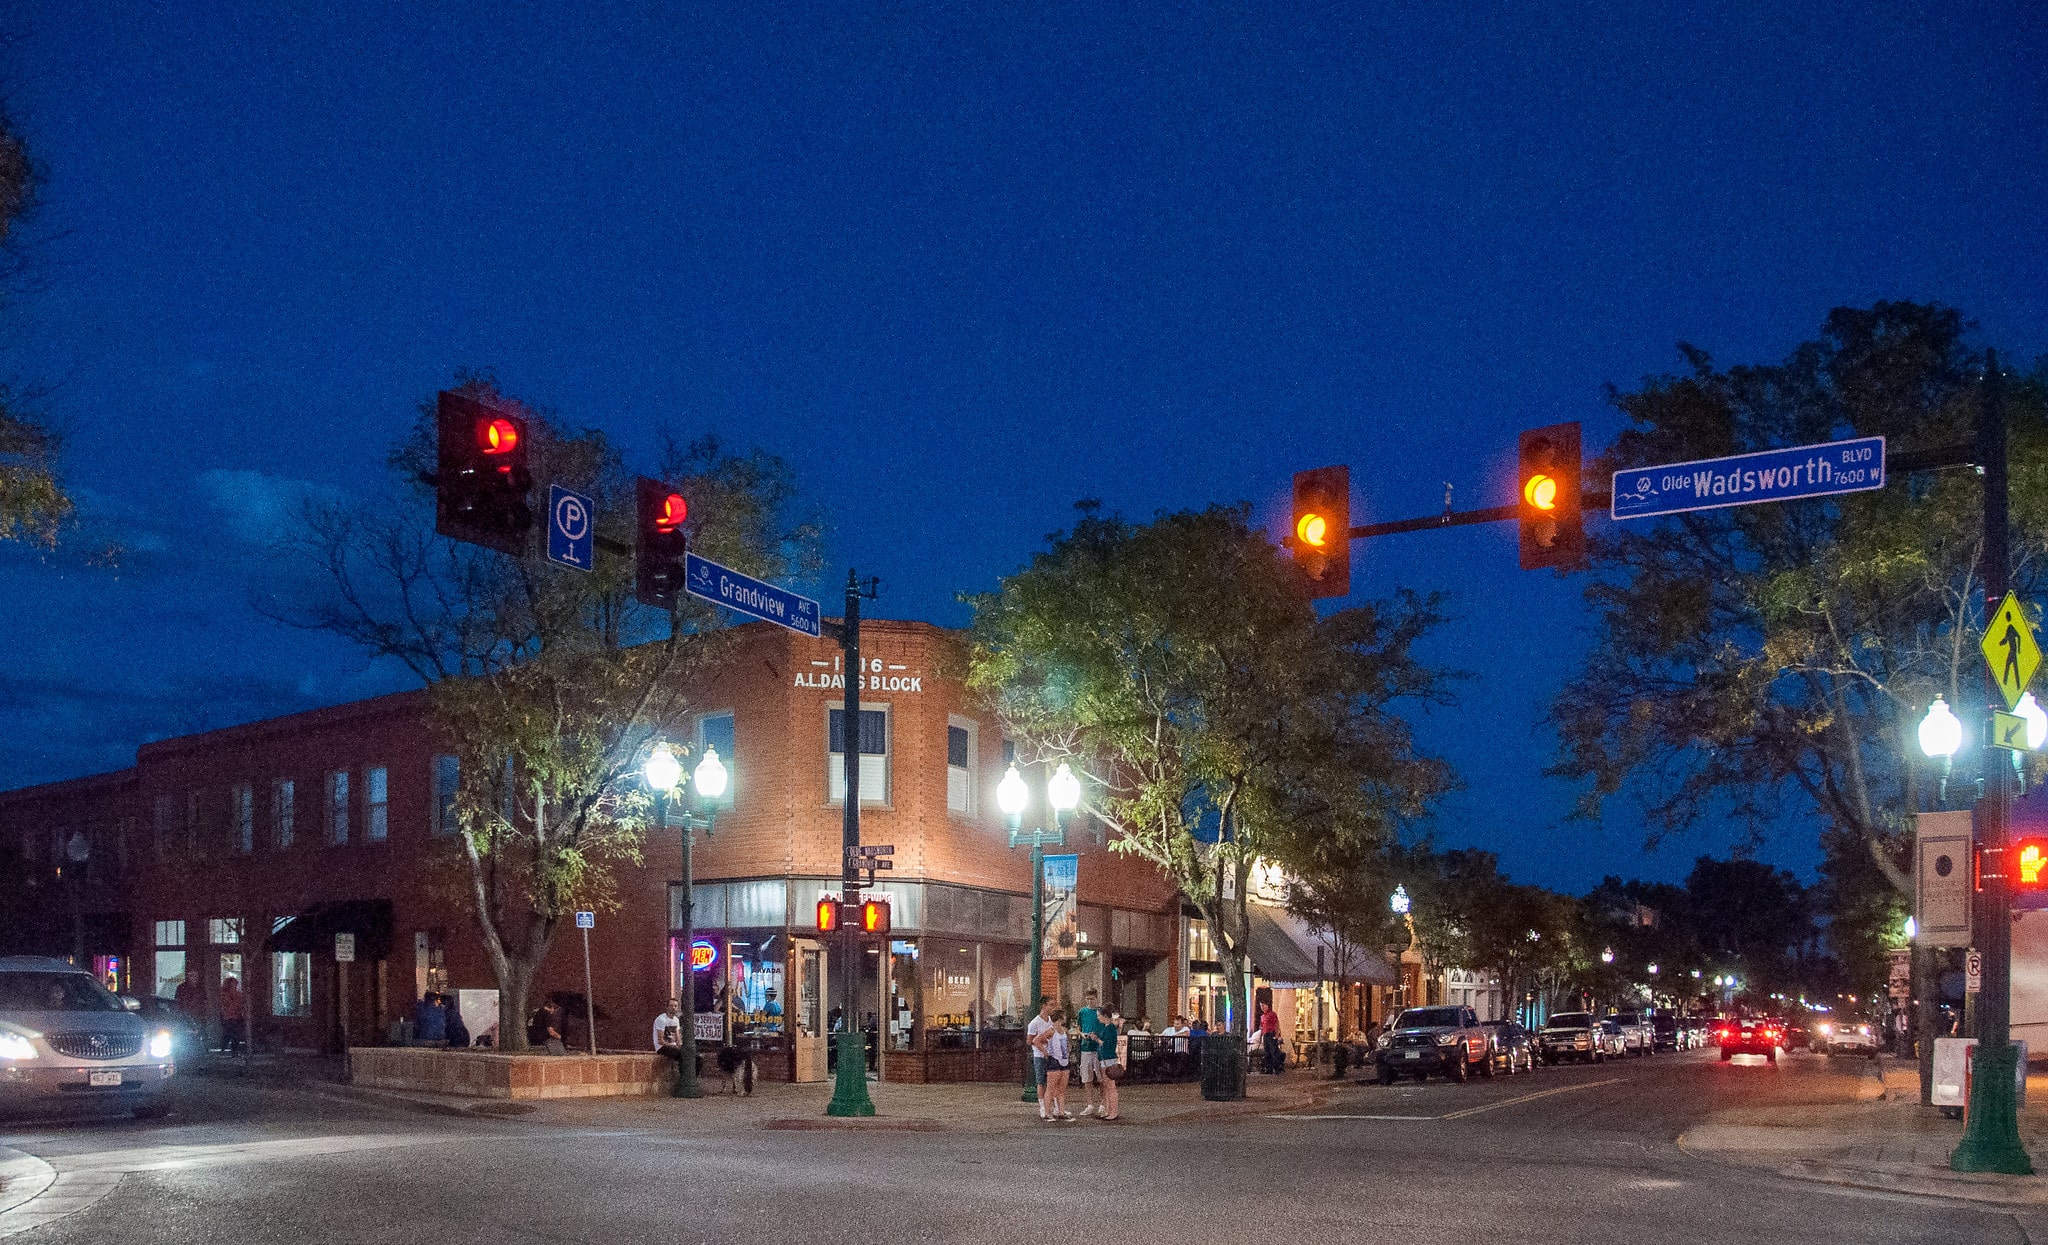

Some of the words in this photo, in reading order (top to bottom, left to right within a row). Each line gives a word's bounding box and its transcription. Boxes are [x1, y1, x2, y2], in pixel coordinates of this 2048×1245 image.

[1661, 475, 1691, 492] Olde
[1693, 456, 1832, 498] Wadsworth
[1842, 448, 1872, 464] BLVD
[1834, 468, 1865, 485] 7600
[1870, 467, 1881, 481] W
[719, 575, 785, 618] Grandview
[798, 600, 811, 615] AVE
[790, 614, 809, 631] 5600
[834, 656, 883, 673] 116
[870, 675, 922, 692] BLOCK
[948, 976, 970, 985] BEER
[732, 1012, 752, 1025] Tap
[753, 1012, 783, 1025] Room
[950, 1014, 971, 1026] Room
